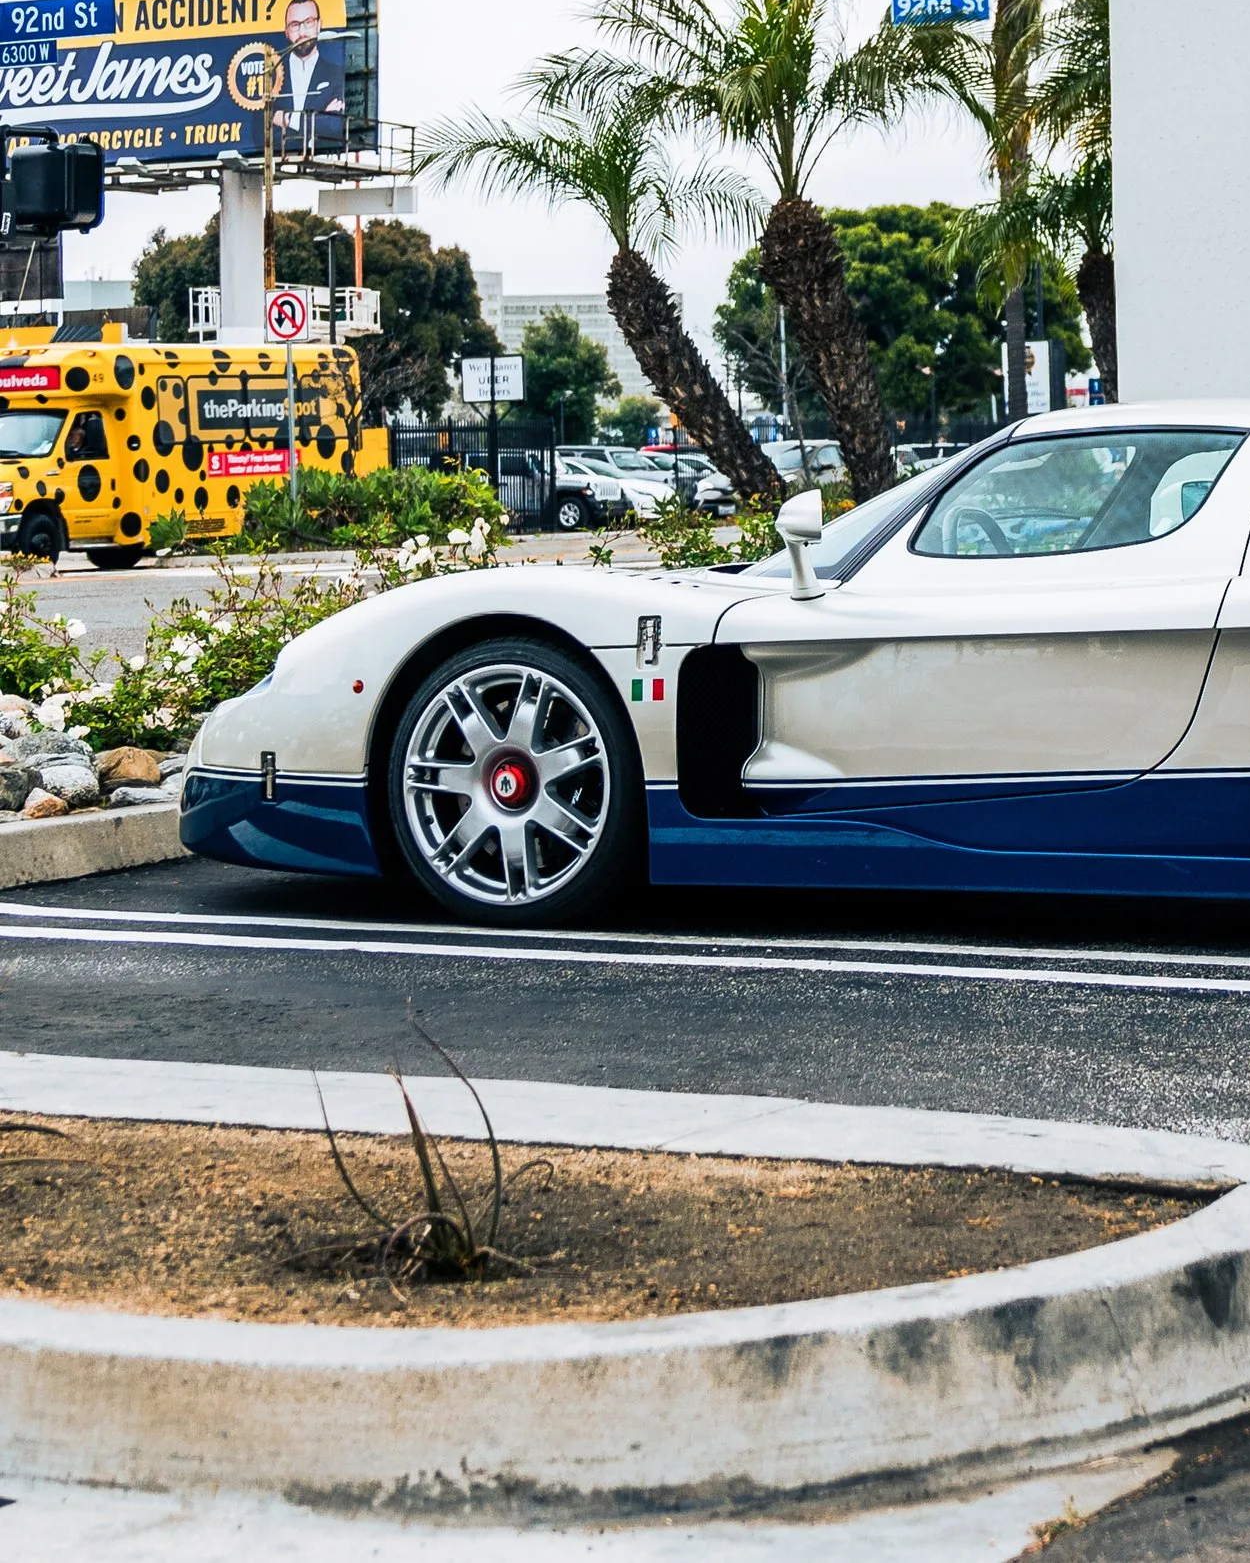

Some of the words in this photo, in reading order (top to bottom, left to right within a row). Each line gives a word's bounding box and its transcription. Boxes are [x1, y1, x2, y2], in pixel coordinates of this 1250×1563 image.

[11, 6, 65, 33] 92nd
[74, 1, 98, 29] St
[2, 43, 37, 64] 6300
[39, 43, 50, 61] W
[69, 41, 218, 103] James
[246, 75, 264, 98] #1
[185, 122, 242, 146] TRUCK
[0, 373, 48, 388] ulveda
